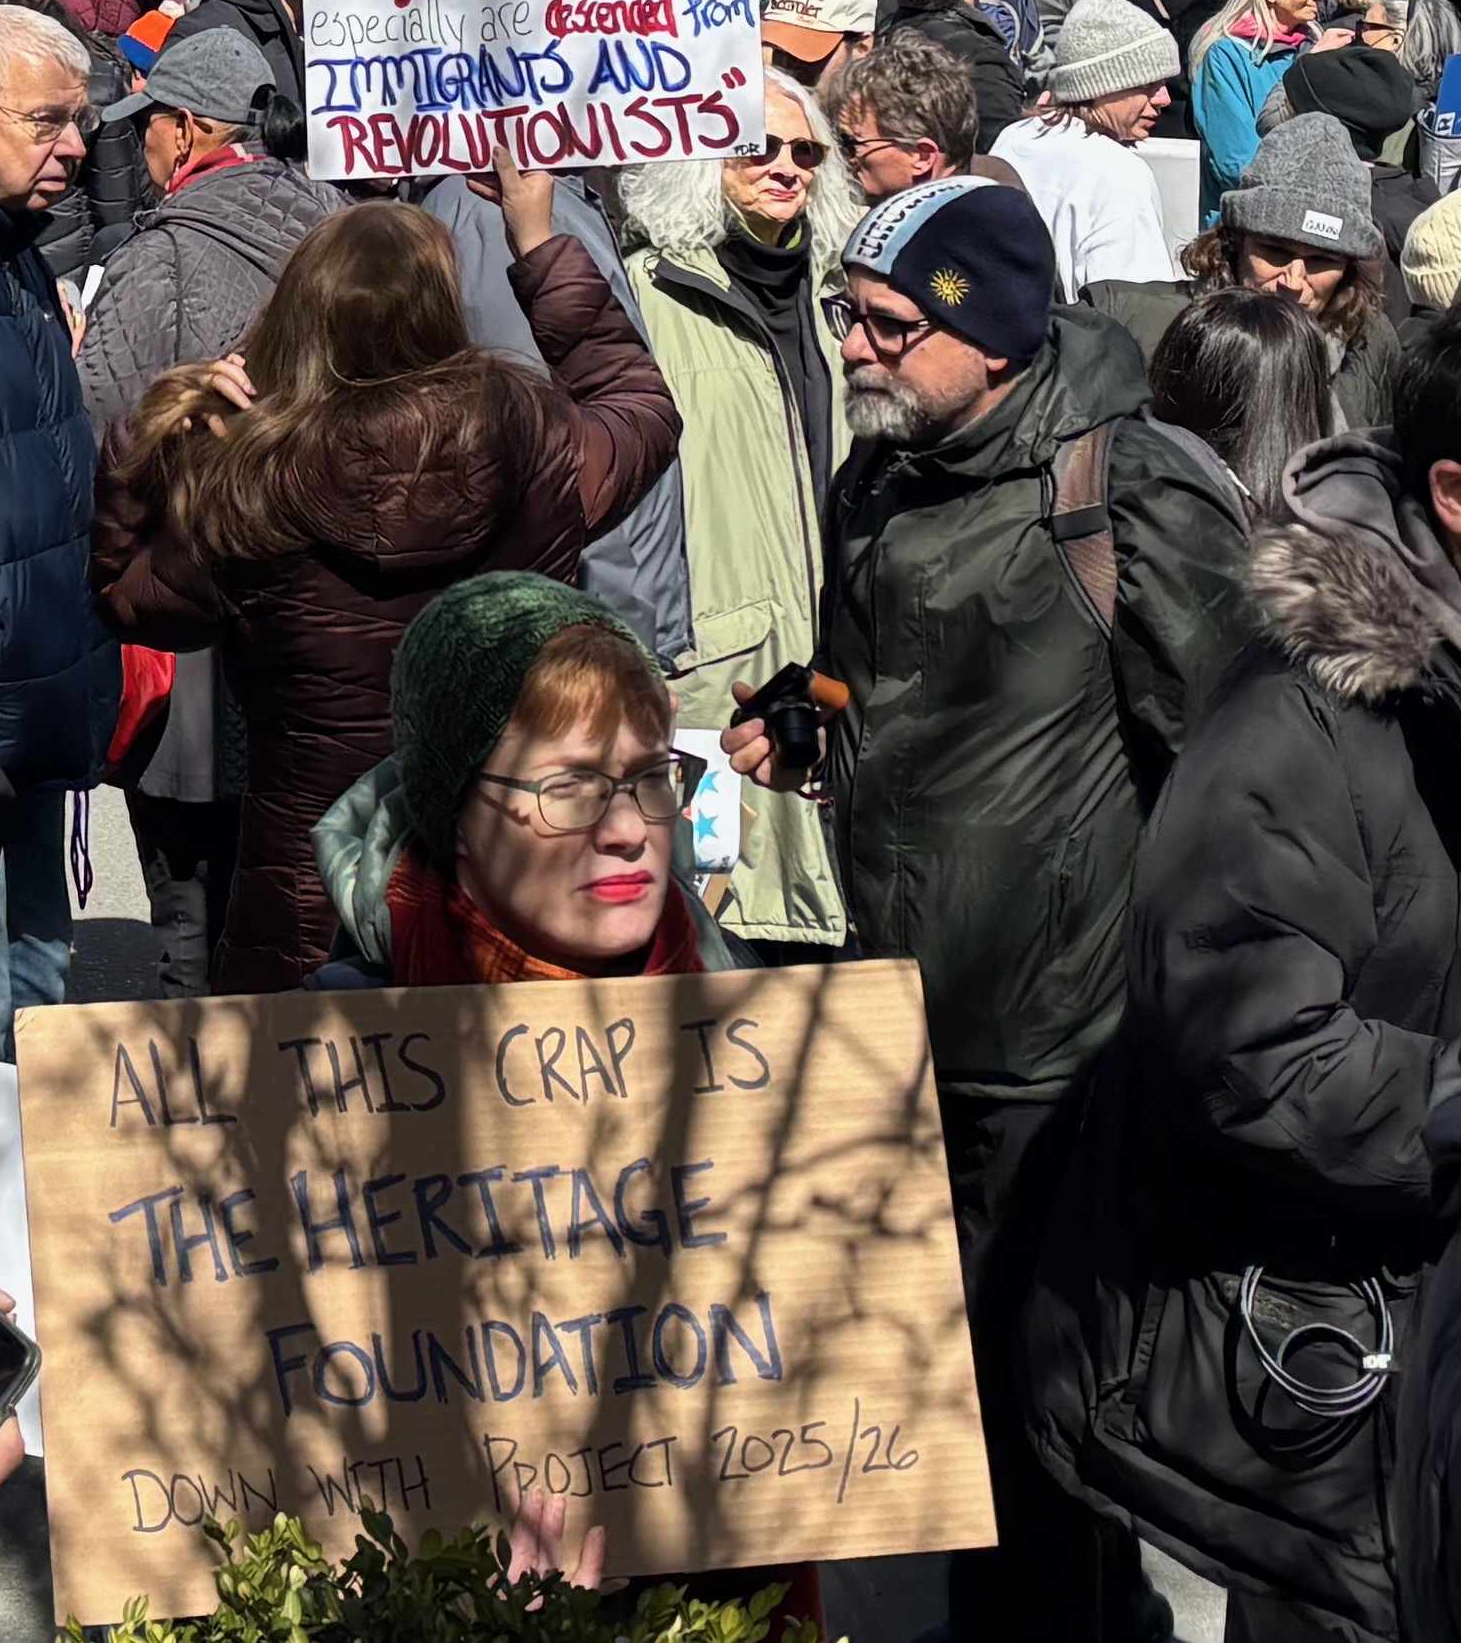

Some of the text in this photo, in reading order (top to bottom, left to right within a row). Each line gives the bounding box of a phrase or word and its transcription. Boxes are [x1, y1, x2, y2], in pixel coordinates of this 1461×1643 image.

[307, 39, 692, 114] IMMIGRANTS AND
[109, 1017, 771, 1130] ALL THIS CRAP IS
[109, 1158, 730, 1288] THE HERITAGE
[265, 1289, 786, 1419] FOUNDATION
[121, 1396, 921, 1536] DOWN WITH PROJECT 2025/26
